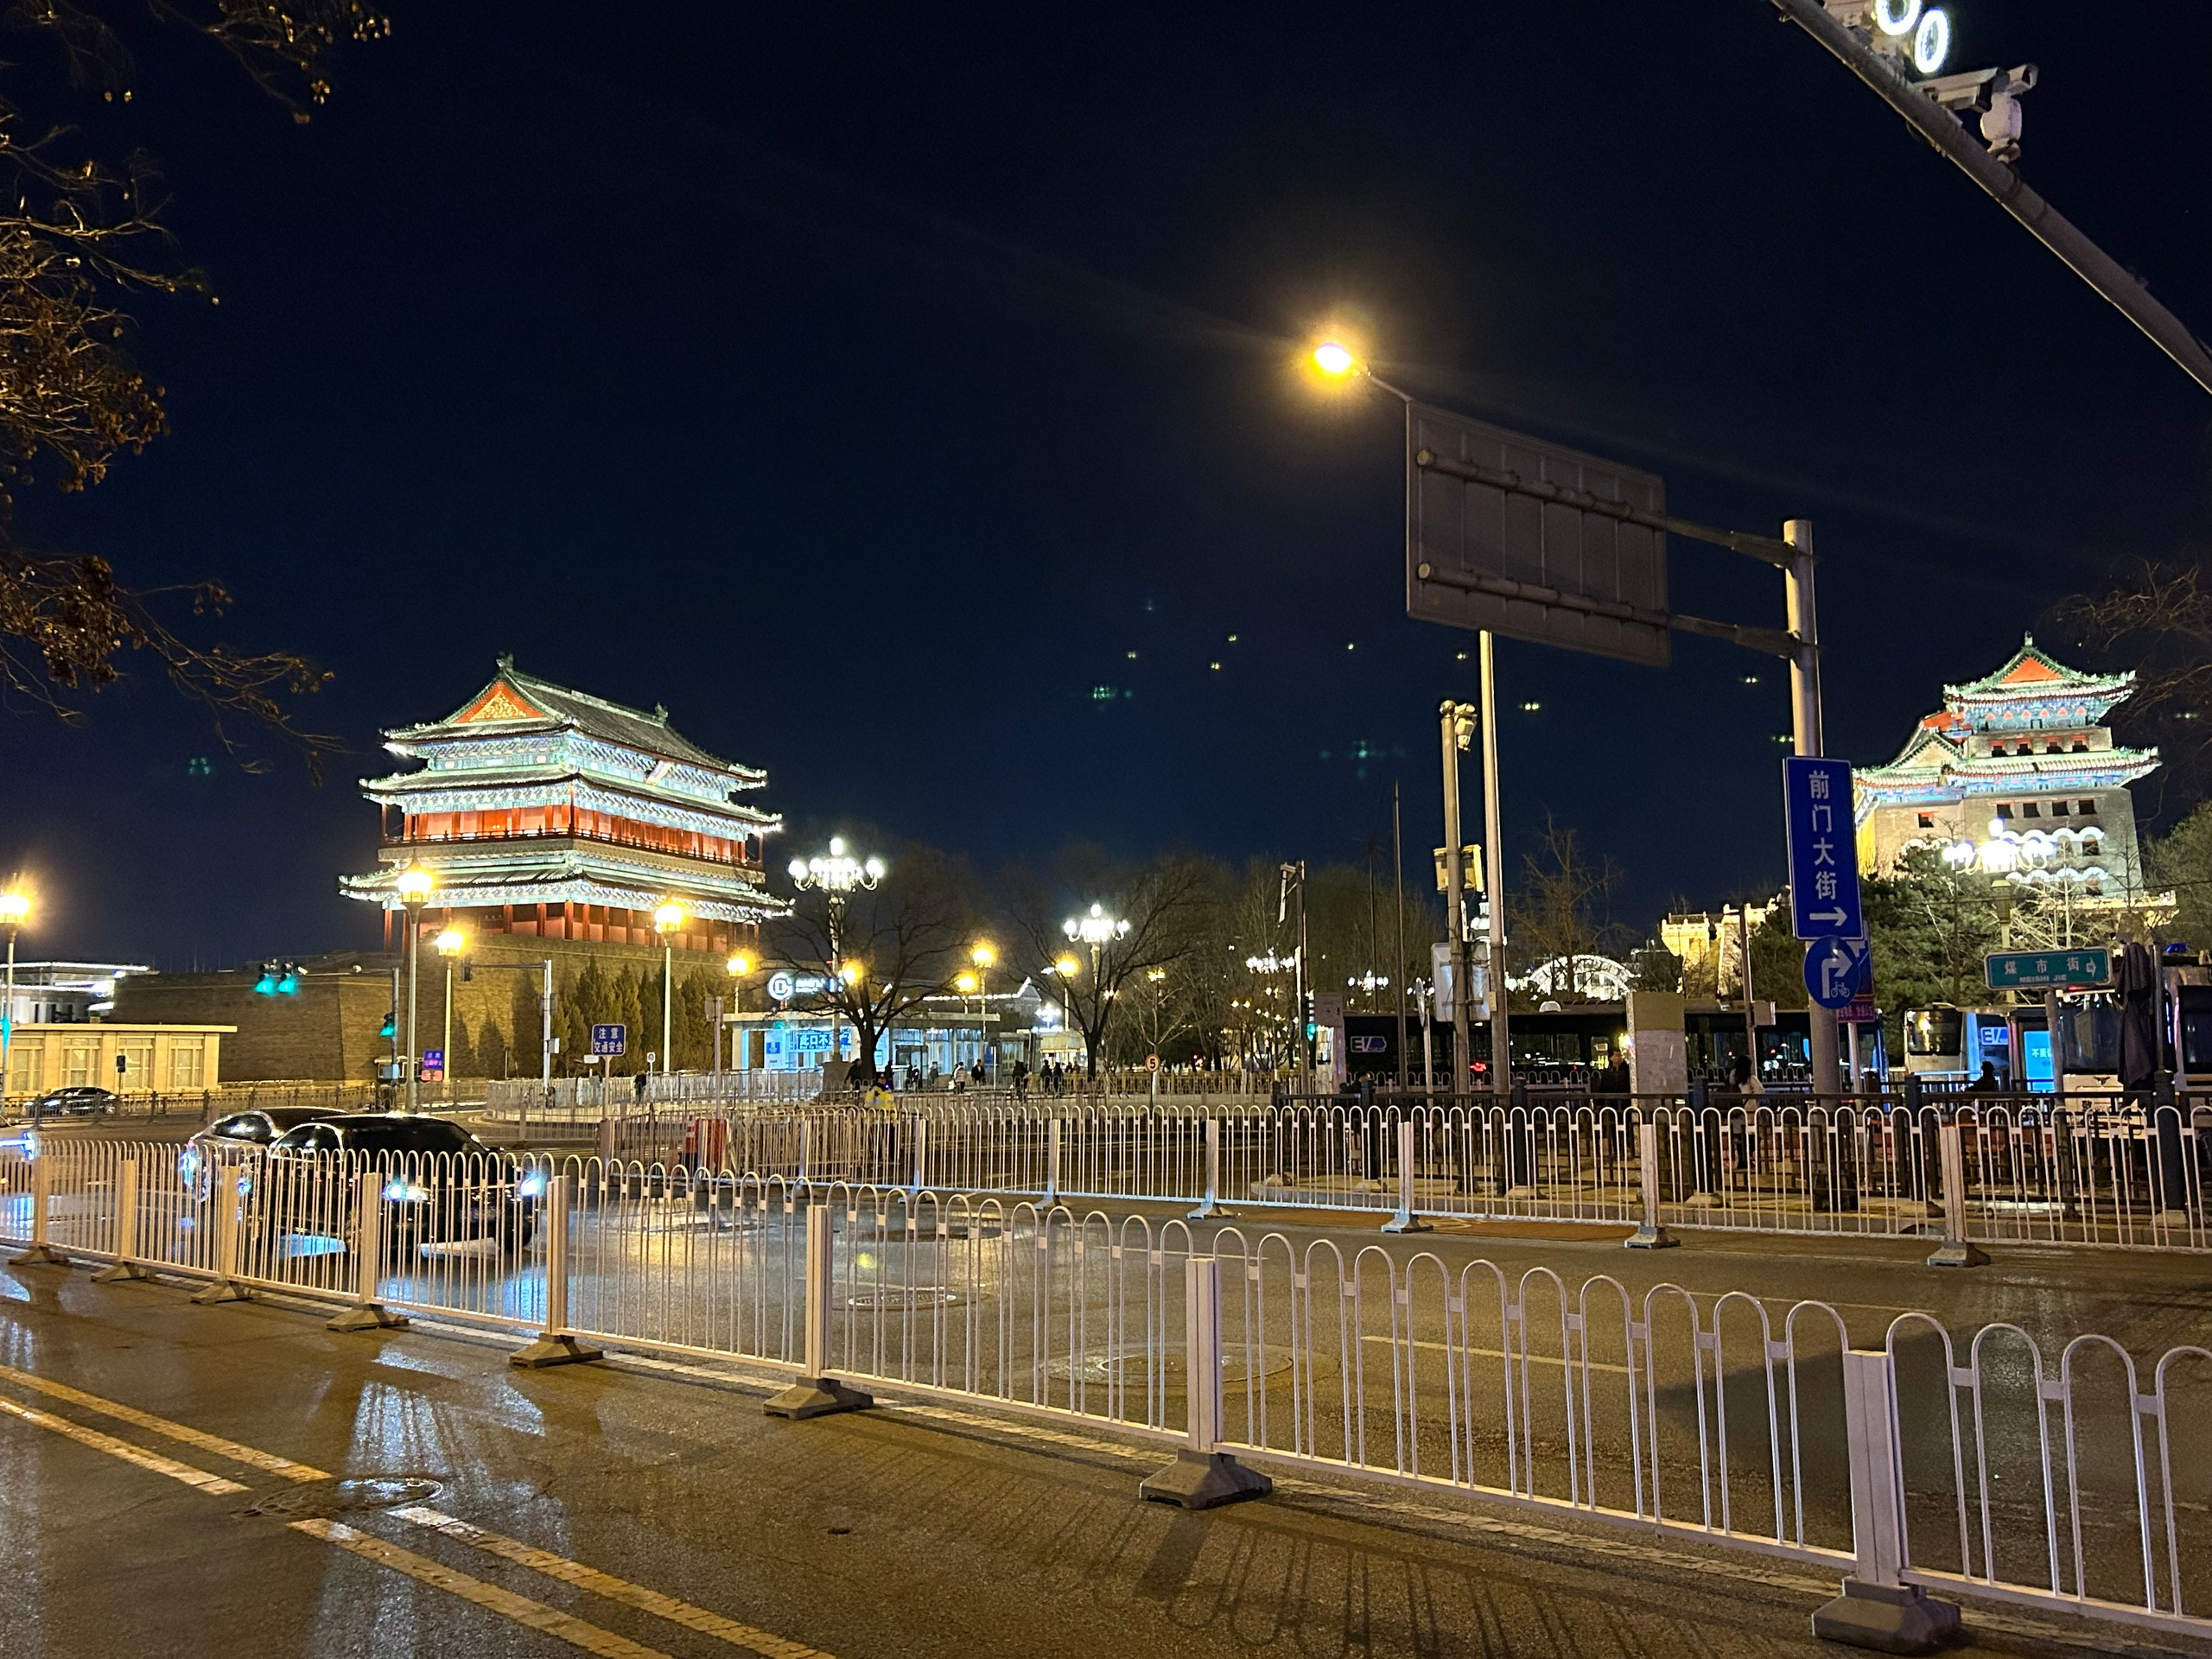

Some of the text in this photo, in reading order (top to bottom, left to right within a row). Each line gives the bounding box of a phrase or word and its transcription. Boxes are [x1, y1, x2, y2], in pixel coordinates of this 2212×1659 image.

[1808, 770, 1837, 899] 前门大街
[2005, 957, 2079, 975] 煤市街
[599, 1027, 619, 1039] 注意
[594, 1040, 623, 1053] 交通安全
[1150, 1058, 1156, 1069] 5
